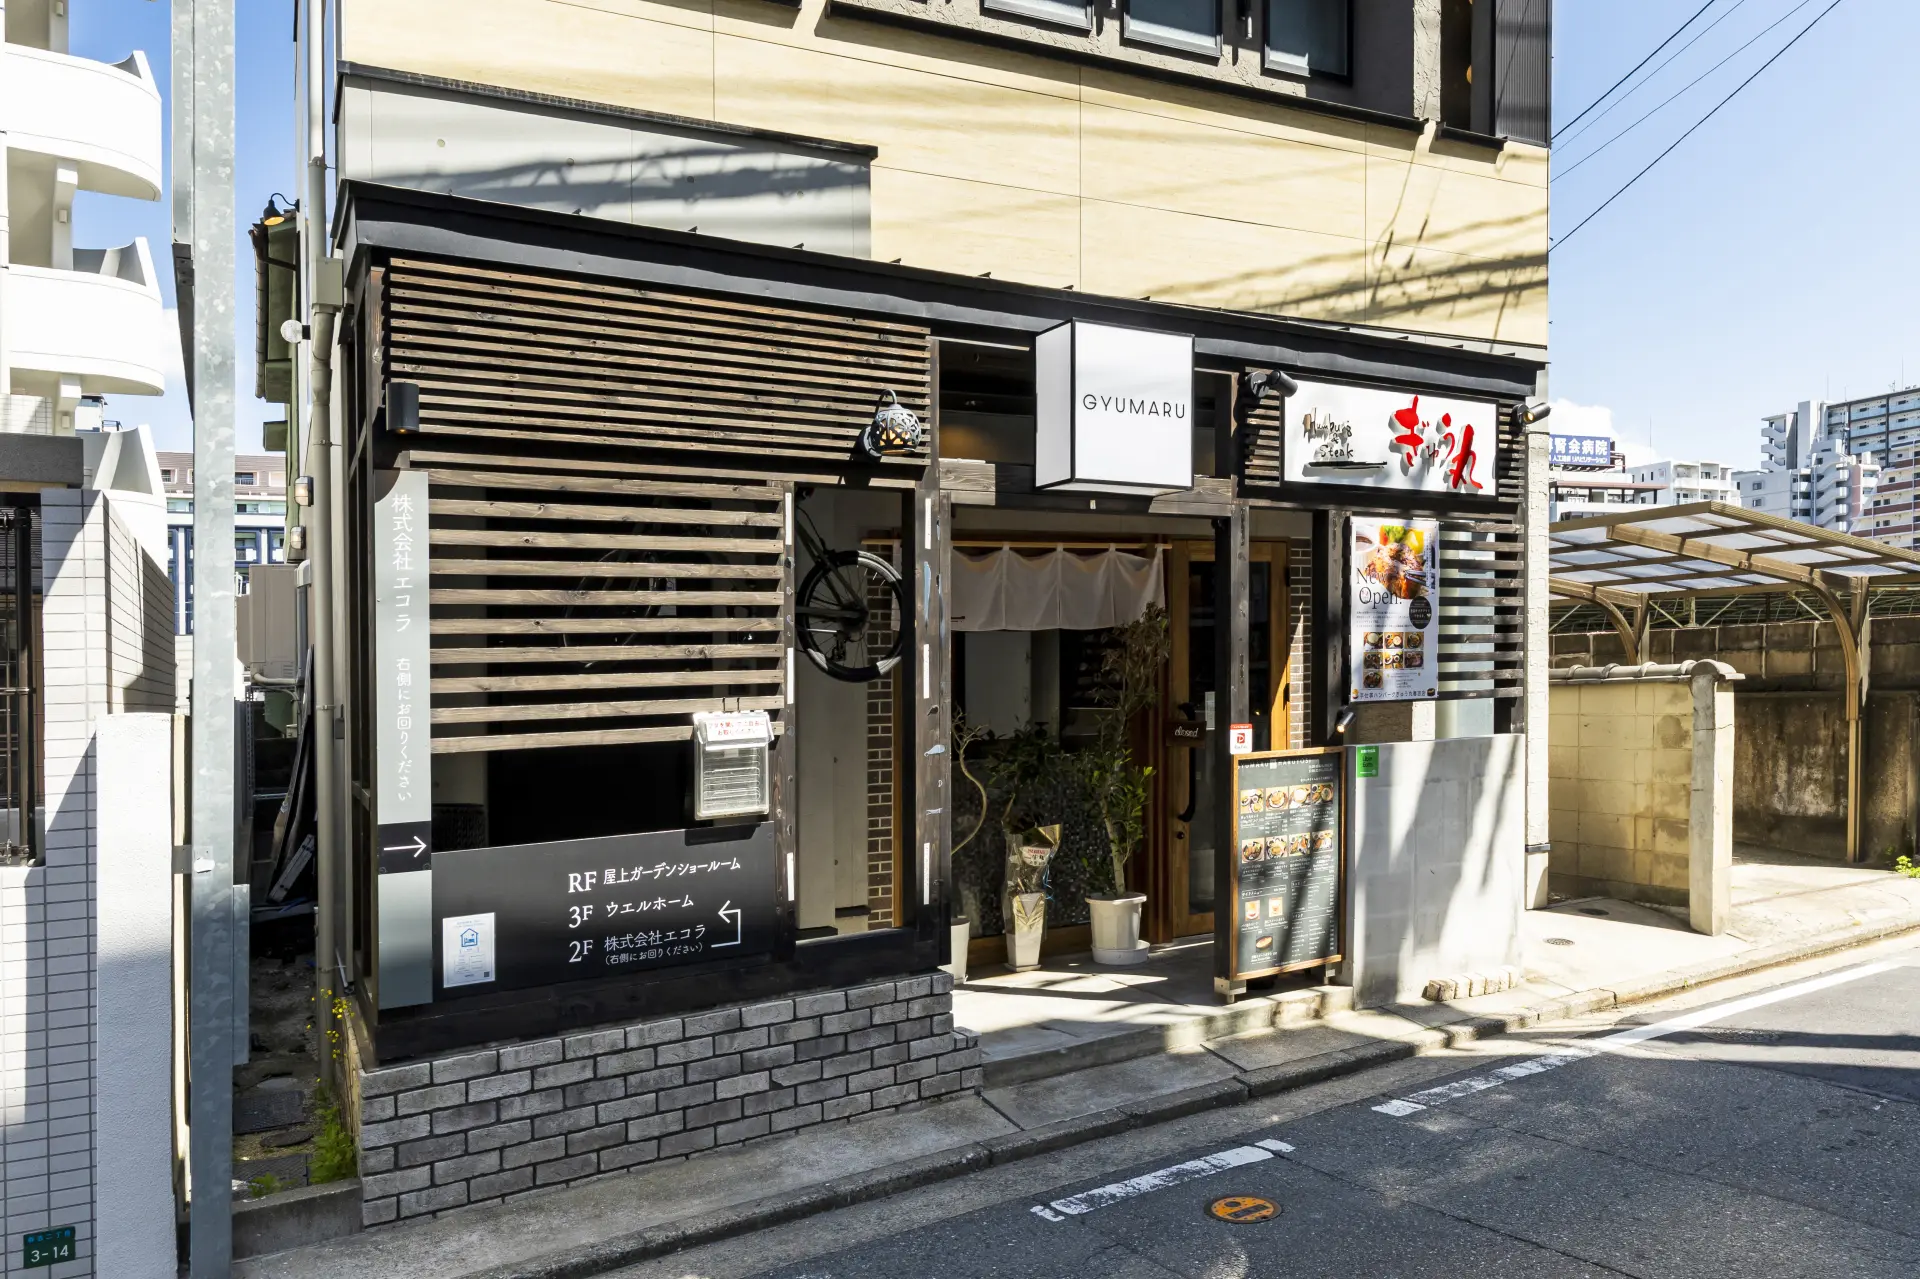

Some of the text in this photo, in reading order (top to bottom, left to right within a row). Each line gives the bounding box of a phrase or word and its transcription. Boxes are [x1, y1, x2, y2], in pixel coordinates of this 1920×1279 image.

[1082, 393, 1185, 419] GYUMARU
[1319, 442, 1354, 459] Steak
[1330, 432, 1340, 444] &
[391, 493, 415, 632] 株式会社エコラ
[1356, 567, 1388, 585] New
[396, 657, 412, 801] 右側にお回りください
[1174, 725, 1199, 738] closed
[568, 857, 741, 893] RF 屋上ガーデンショールーム
[568, 894, 694, 929] 3F ウエルホーム
[568, 924, 706, 963] 2F 株式会社エコラ
[605, 942, 703, 966] (右側にお回りください)
[30, 1244, 69, 1263] 3-14
